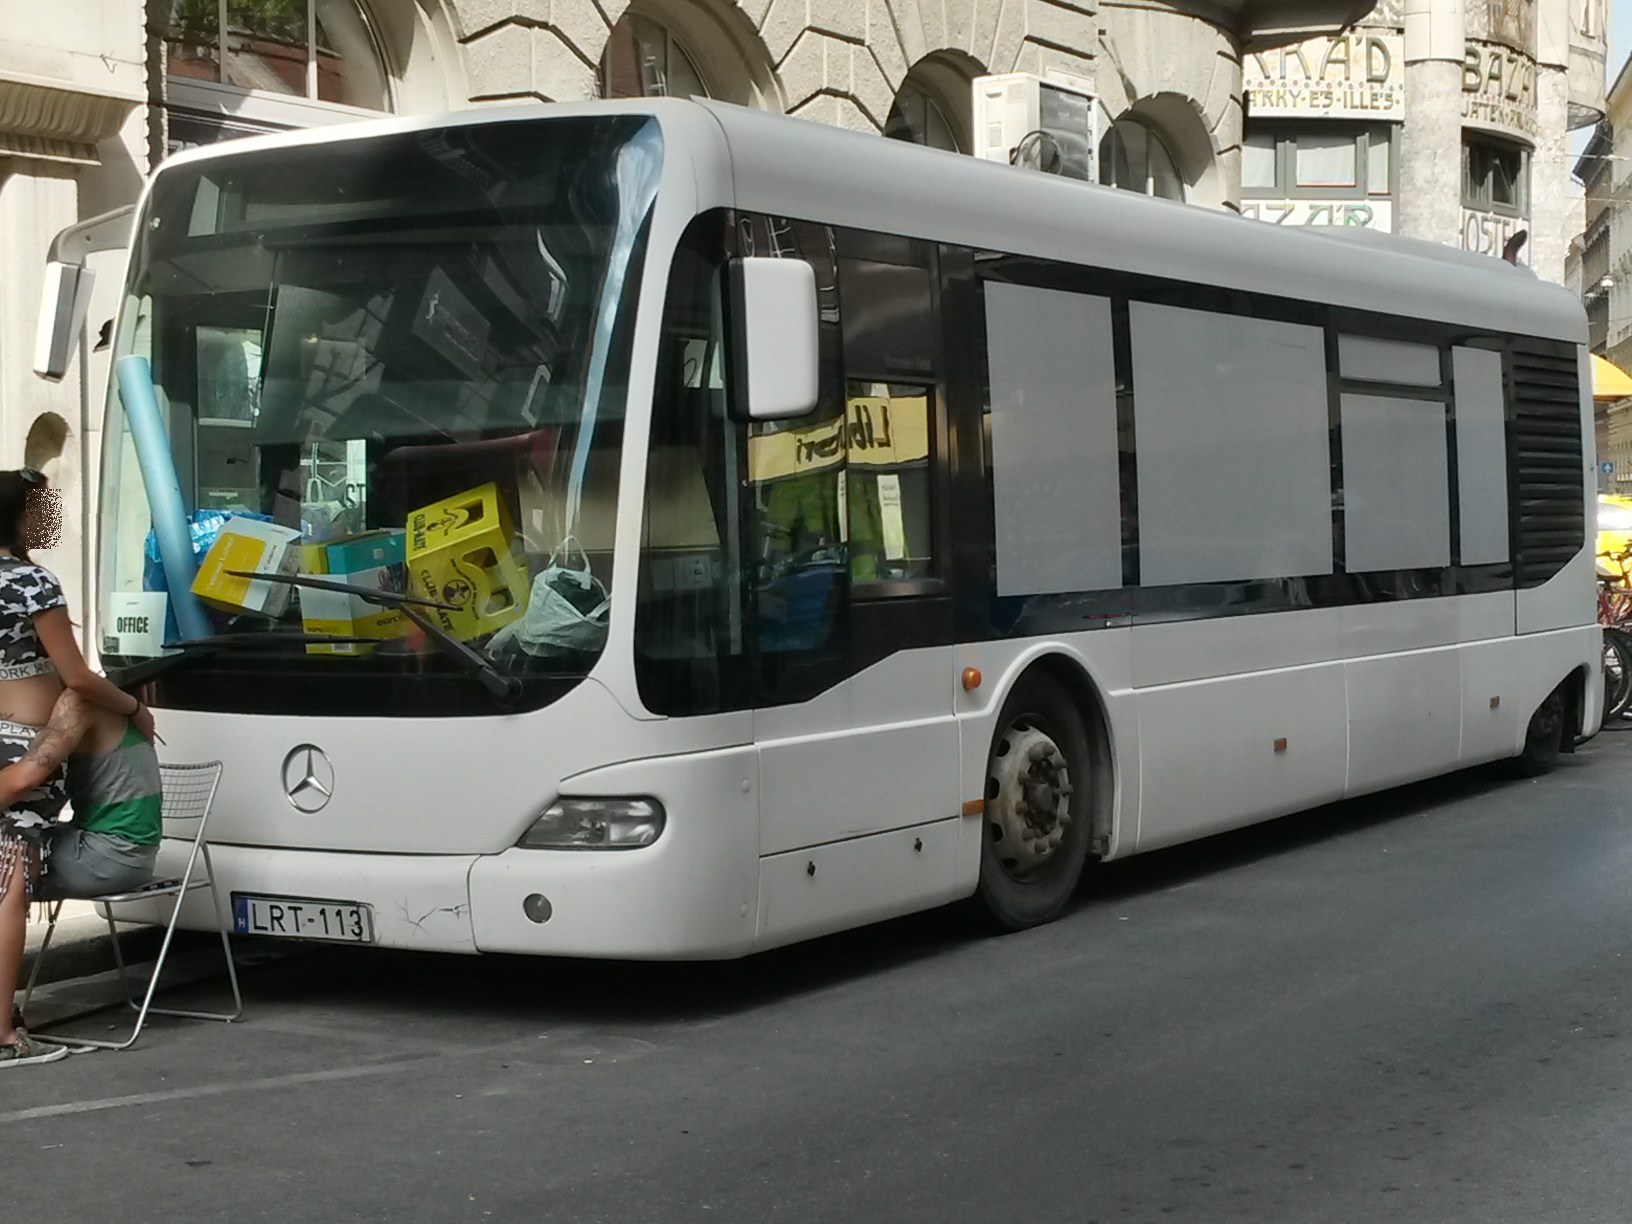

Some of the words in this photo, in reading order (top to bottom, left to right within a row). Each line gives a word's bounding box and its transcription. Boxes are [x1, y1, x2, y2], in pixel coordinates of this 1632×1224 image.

[117, 617, 149, 633] OFFICE
[238, 918, 245, 927] H
[252, 903, 363, 937] LRT-113
